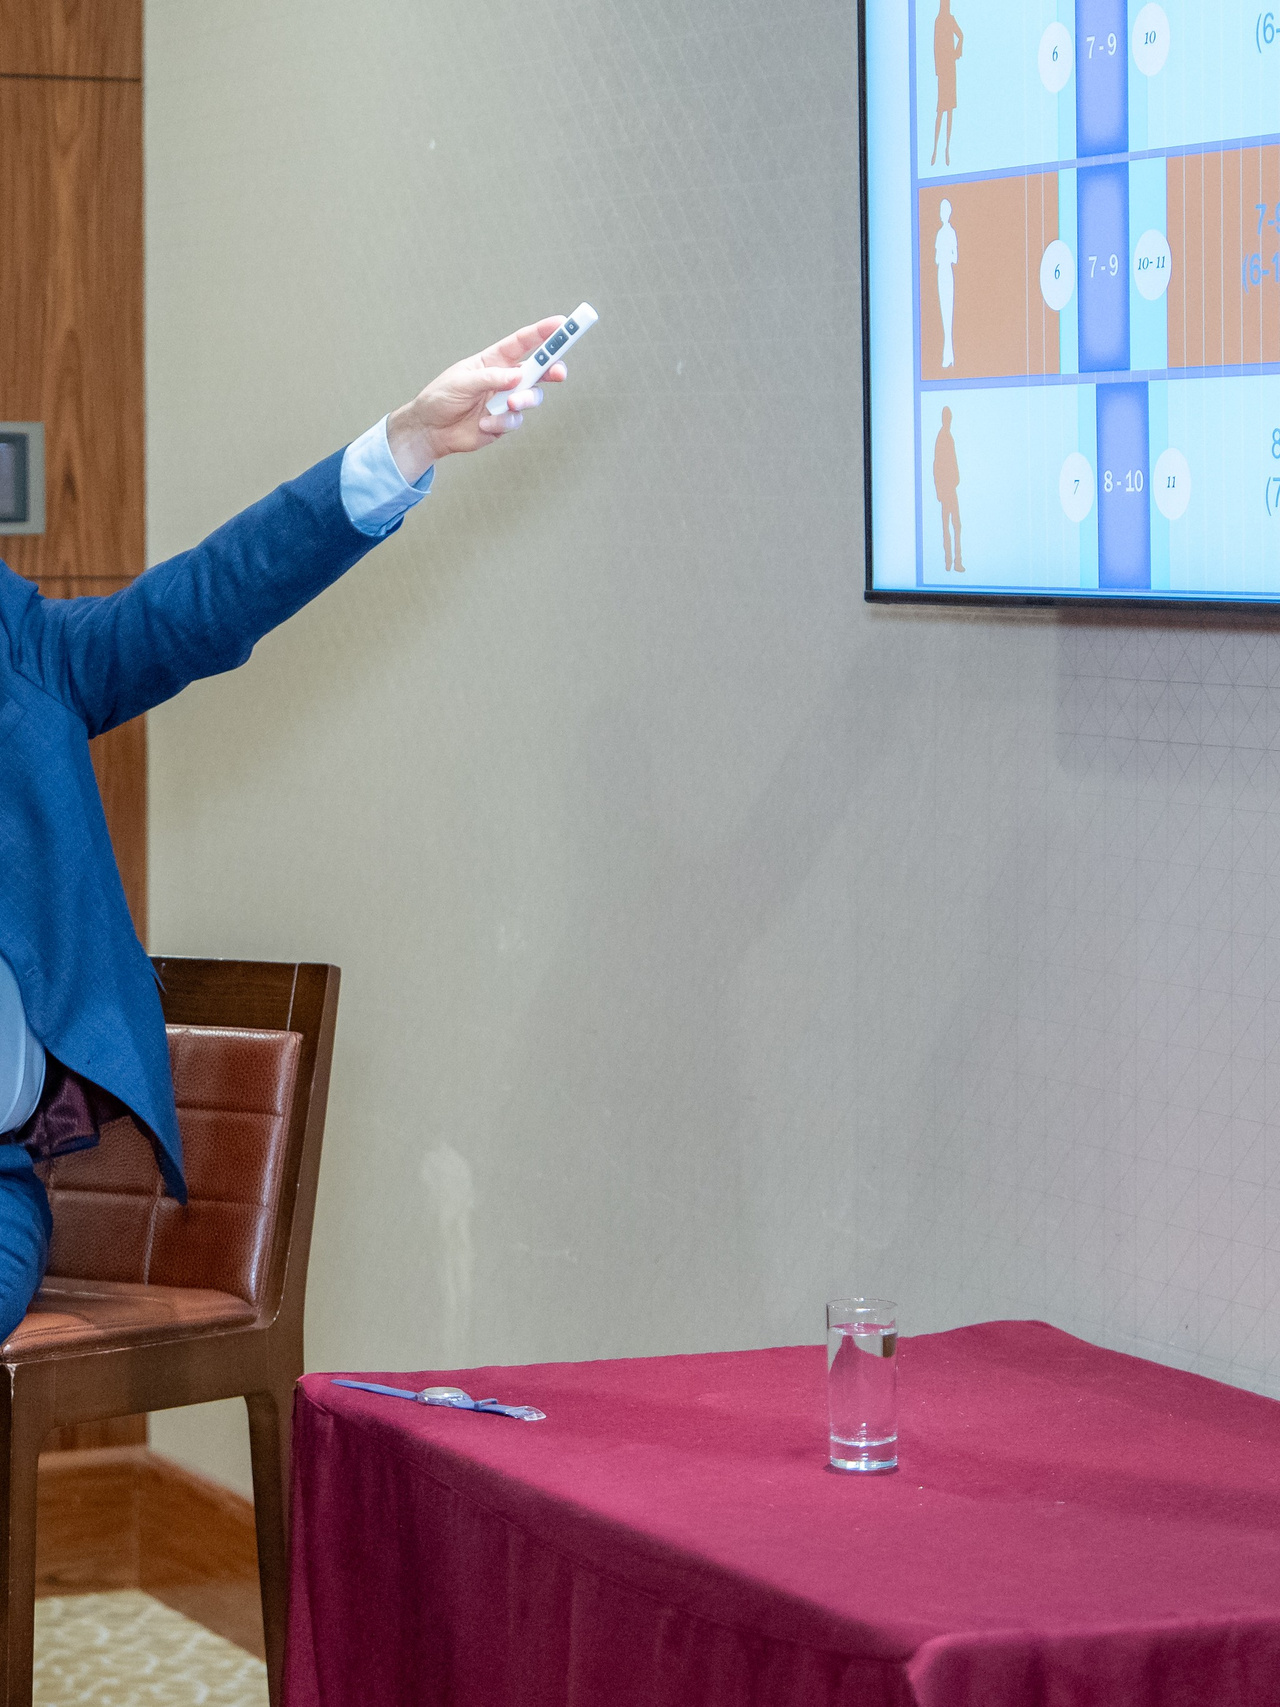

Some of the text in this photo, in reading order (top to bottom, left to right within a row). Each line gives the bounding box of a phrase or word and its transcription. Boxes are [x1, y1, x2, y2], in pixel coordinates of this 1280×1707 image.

[1144, 30, 1157, 45] 10
[1052, 45, 1059, 62] 6
[1054, 263, 1061, 280] 6
[1073, 479, 1080, 495] 7
[1167, 476, 1176, 488] 11
